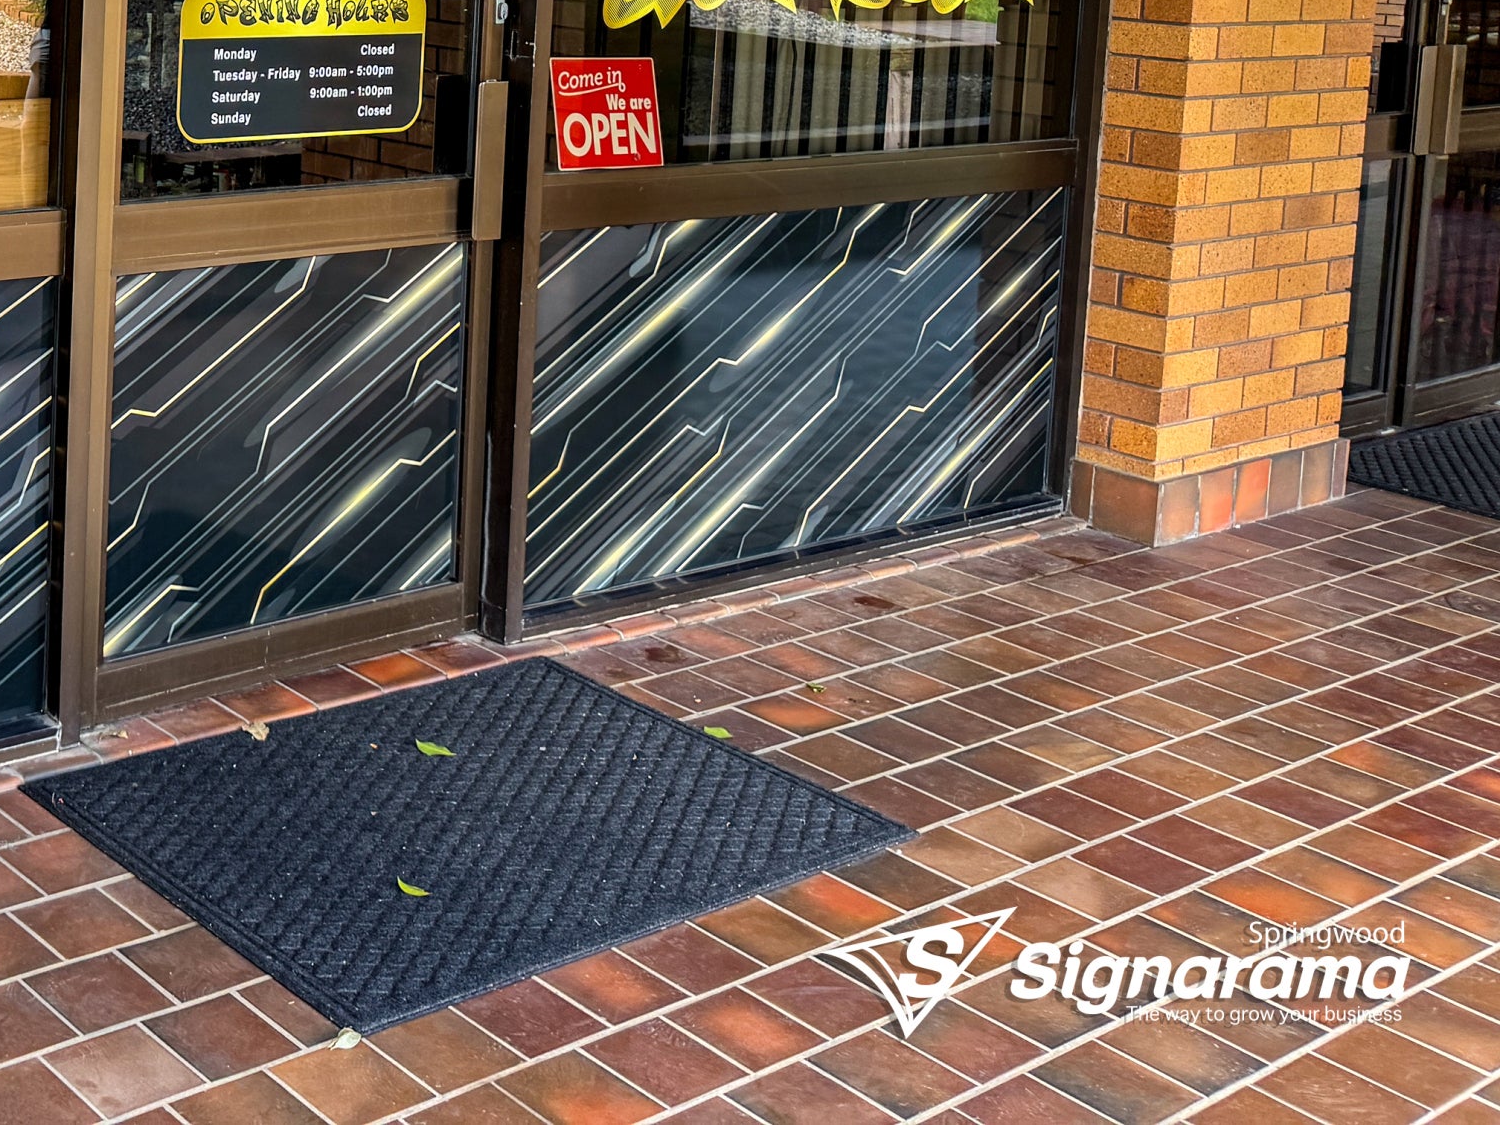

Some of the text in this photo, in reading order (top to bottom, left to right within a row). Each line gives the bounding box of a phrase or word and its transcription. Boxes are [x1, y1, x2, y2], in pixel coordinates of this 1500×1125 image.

[213, 43, 395, 62] Monday Closed
[212, 69, 258, 83] Tuesday
[267, 67, 301, 82] Friday
[308, 66, 347, 79] 9:00am
[356, 65, 394, 78] 5:00pm
[558, 66, 626, 93] Come in
[211, 90, 261, 104] Saturday
[309, 86, 348, 99] 9:00am
[357, 85, 393, 98] 1:00pm
[605, 93, 652, 110] We are
[210, 104, 392, 126] Sunday Closed
[563, 112, 657, 158] OPEN
